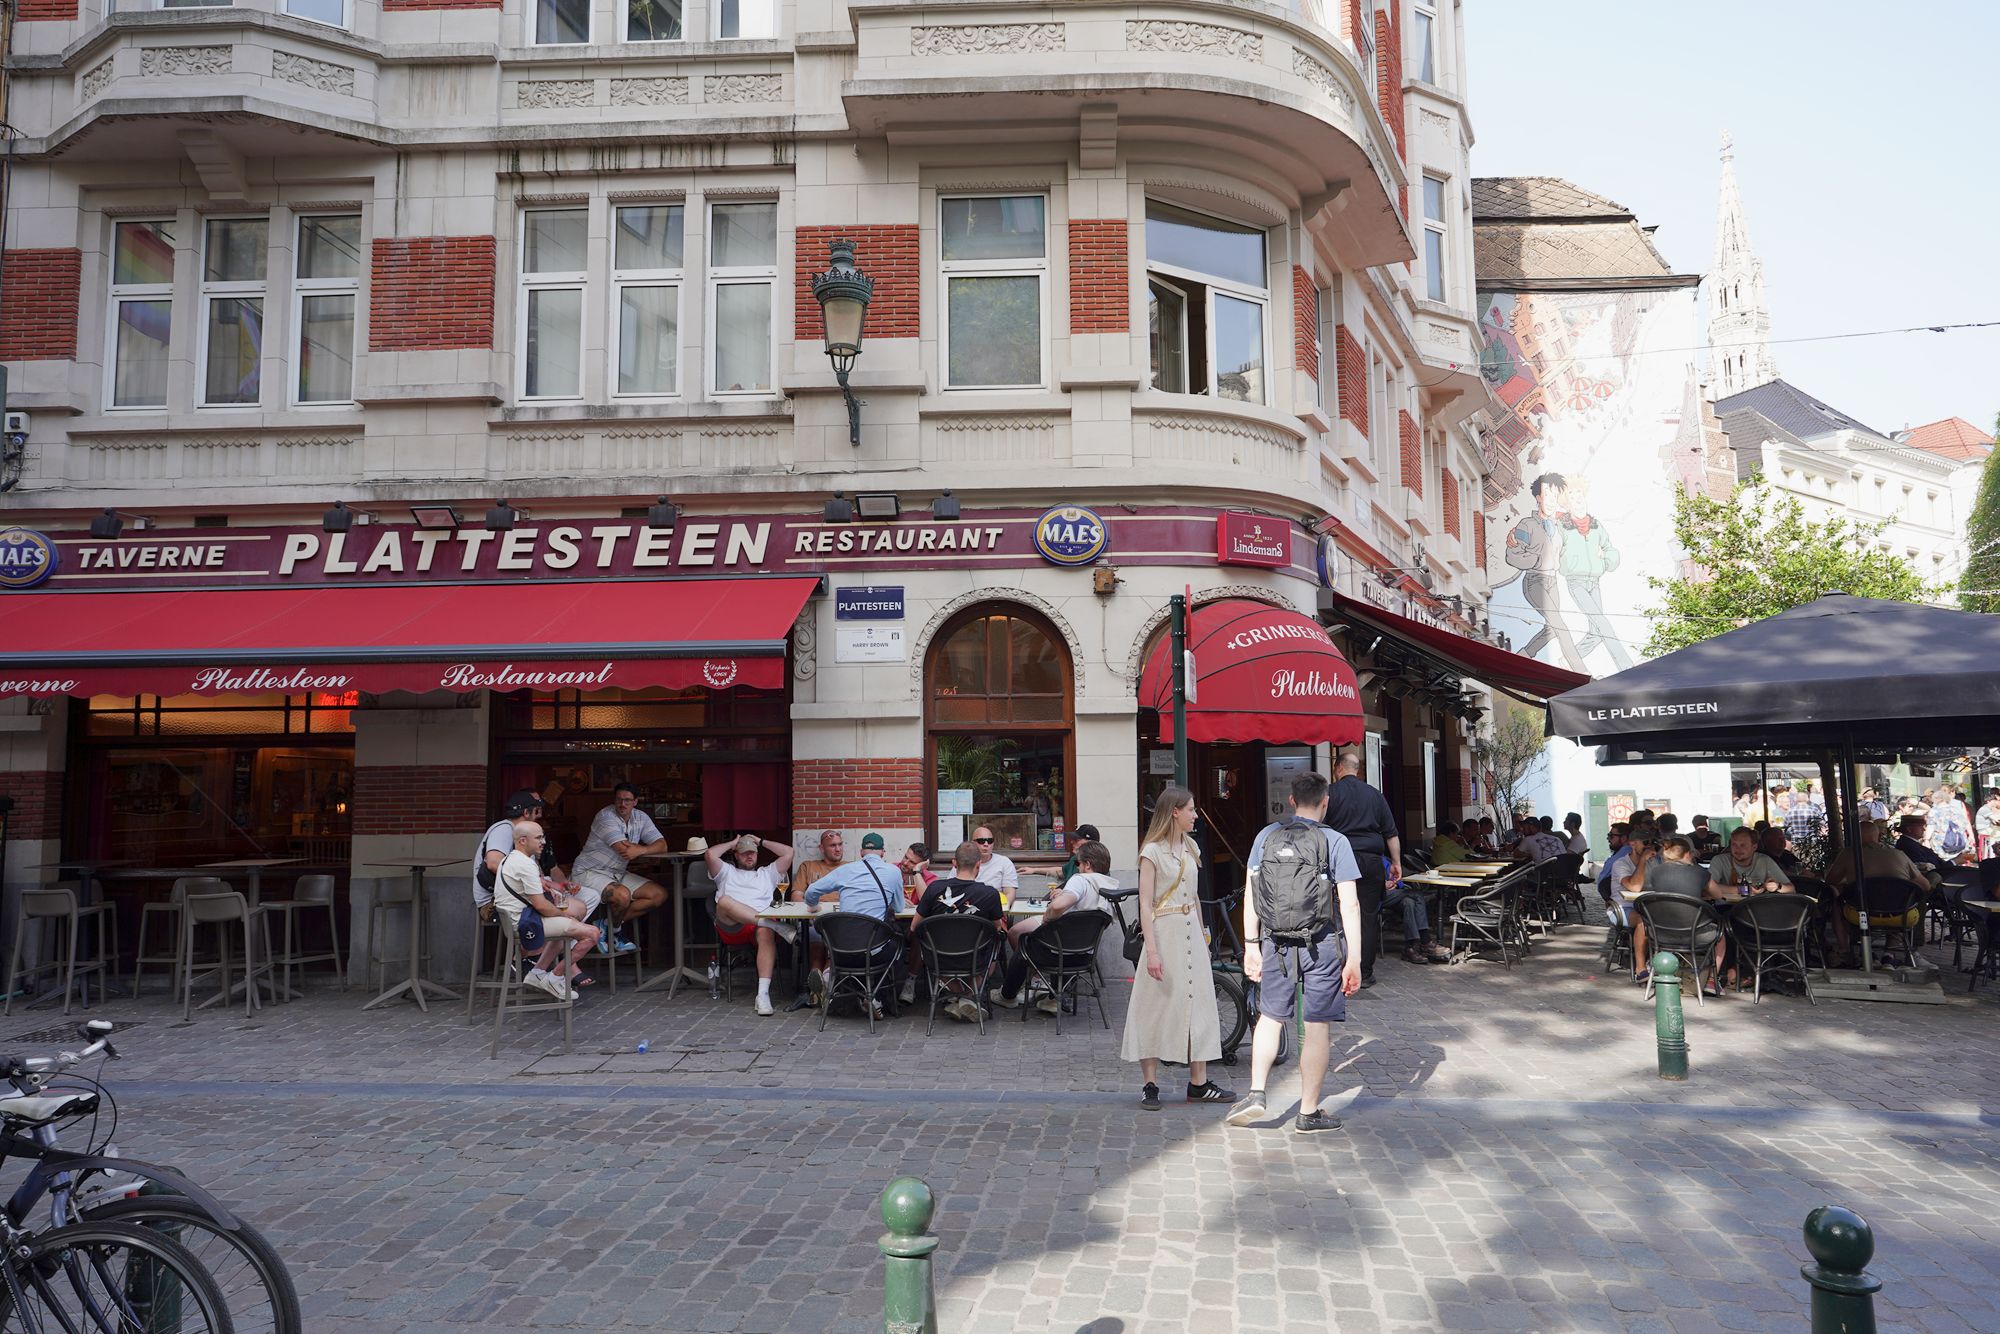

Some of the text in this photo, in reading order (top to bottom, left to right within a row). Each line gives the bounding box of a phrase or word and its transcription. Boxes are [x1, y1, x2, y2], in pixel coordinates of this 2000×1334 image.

[1039, 523, 1102, 544] MAES
[78, 522, 1003, 575] TAVERNE PLATTESTEEN RESTAURANT
[838, 602, 902, 611] PLATTESTEEN
[440, 662, 614, 687] Restaurant
[709, 664, 731, 672] Depuis
[191, 667, 354, 691] Plattesteen
[1271, 669, 1355, 700] Plattesteen
[1588, 702, 1719, 721] LE PLATTESTEEN
[1756, 771, 1779, 779] STION
